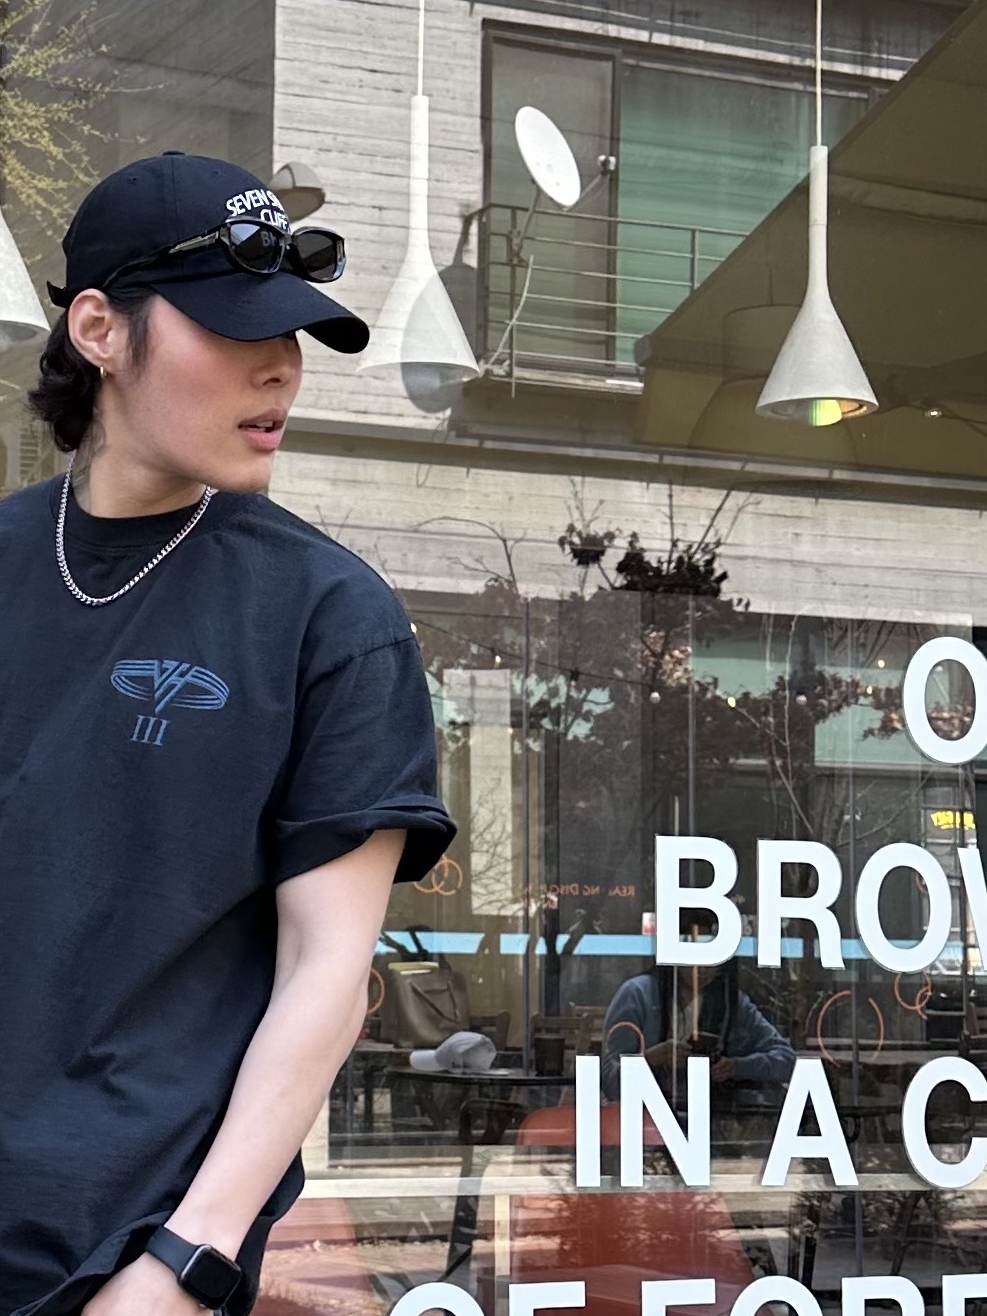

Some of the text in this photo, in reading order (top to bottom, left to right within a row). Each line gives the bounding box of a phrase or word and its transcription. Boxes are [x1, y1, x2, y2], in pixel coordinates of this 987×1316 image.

[226, 188, 270, 216] SEVEN
[130, 714, 171, 747] III
[654, 835, 987, 974] BRO
[575, 1055, 710, 1188] IN
[761, 1058, 859, 1186] A
